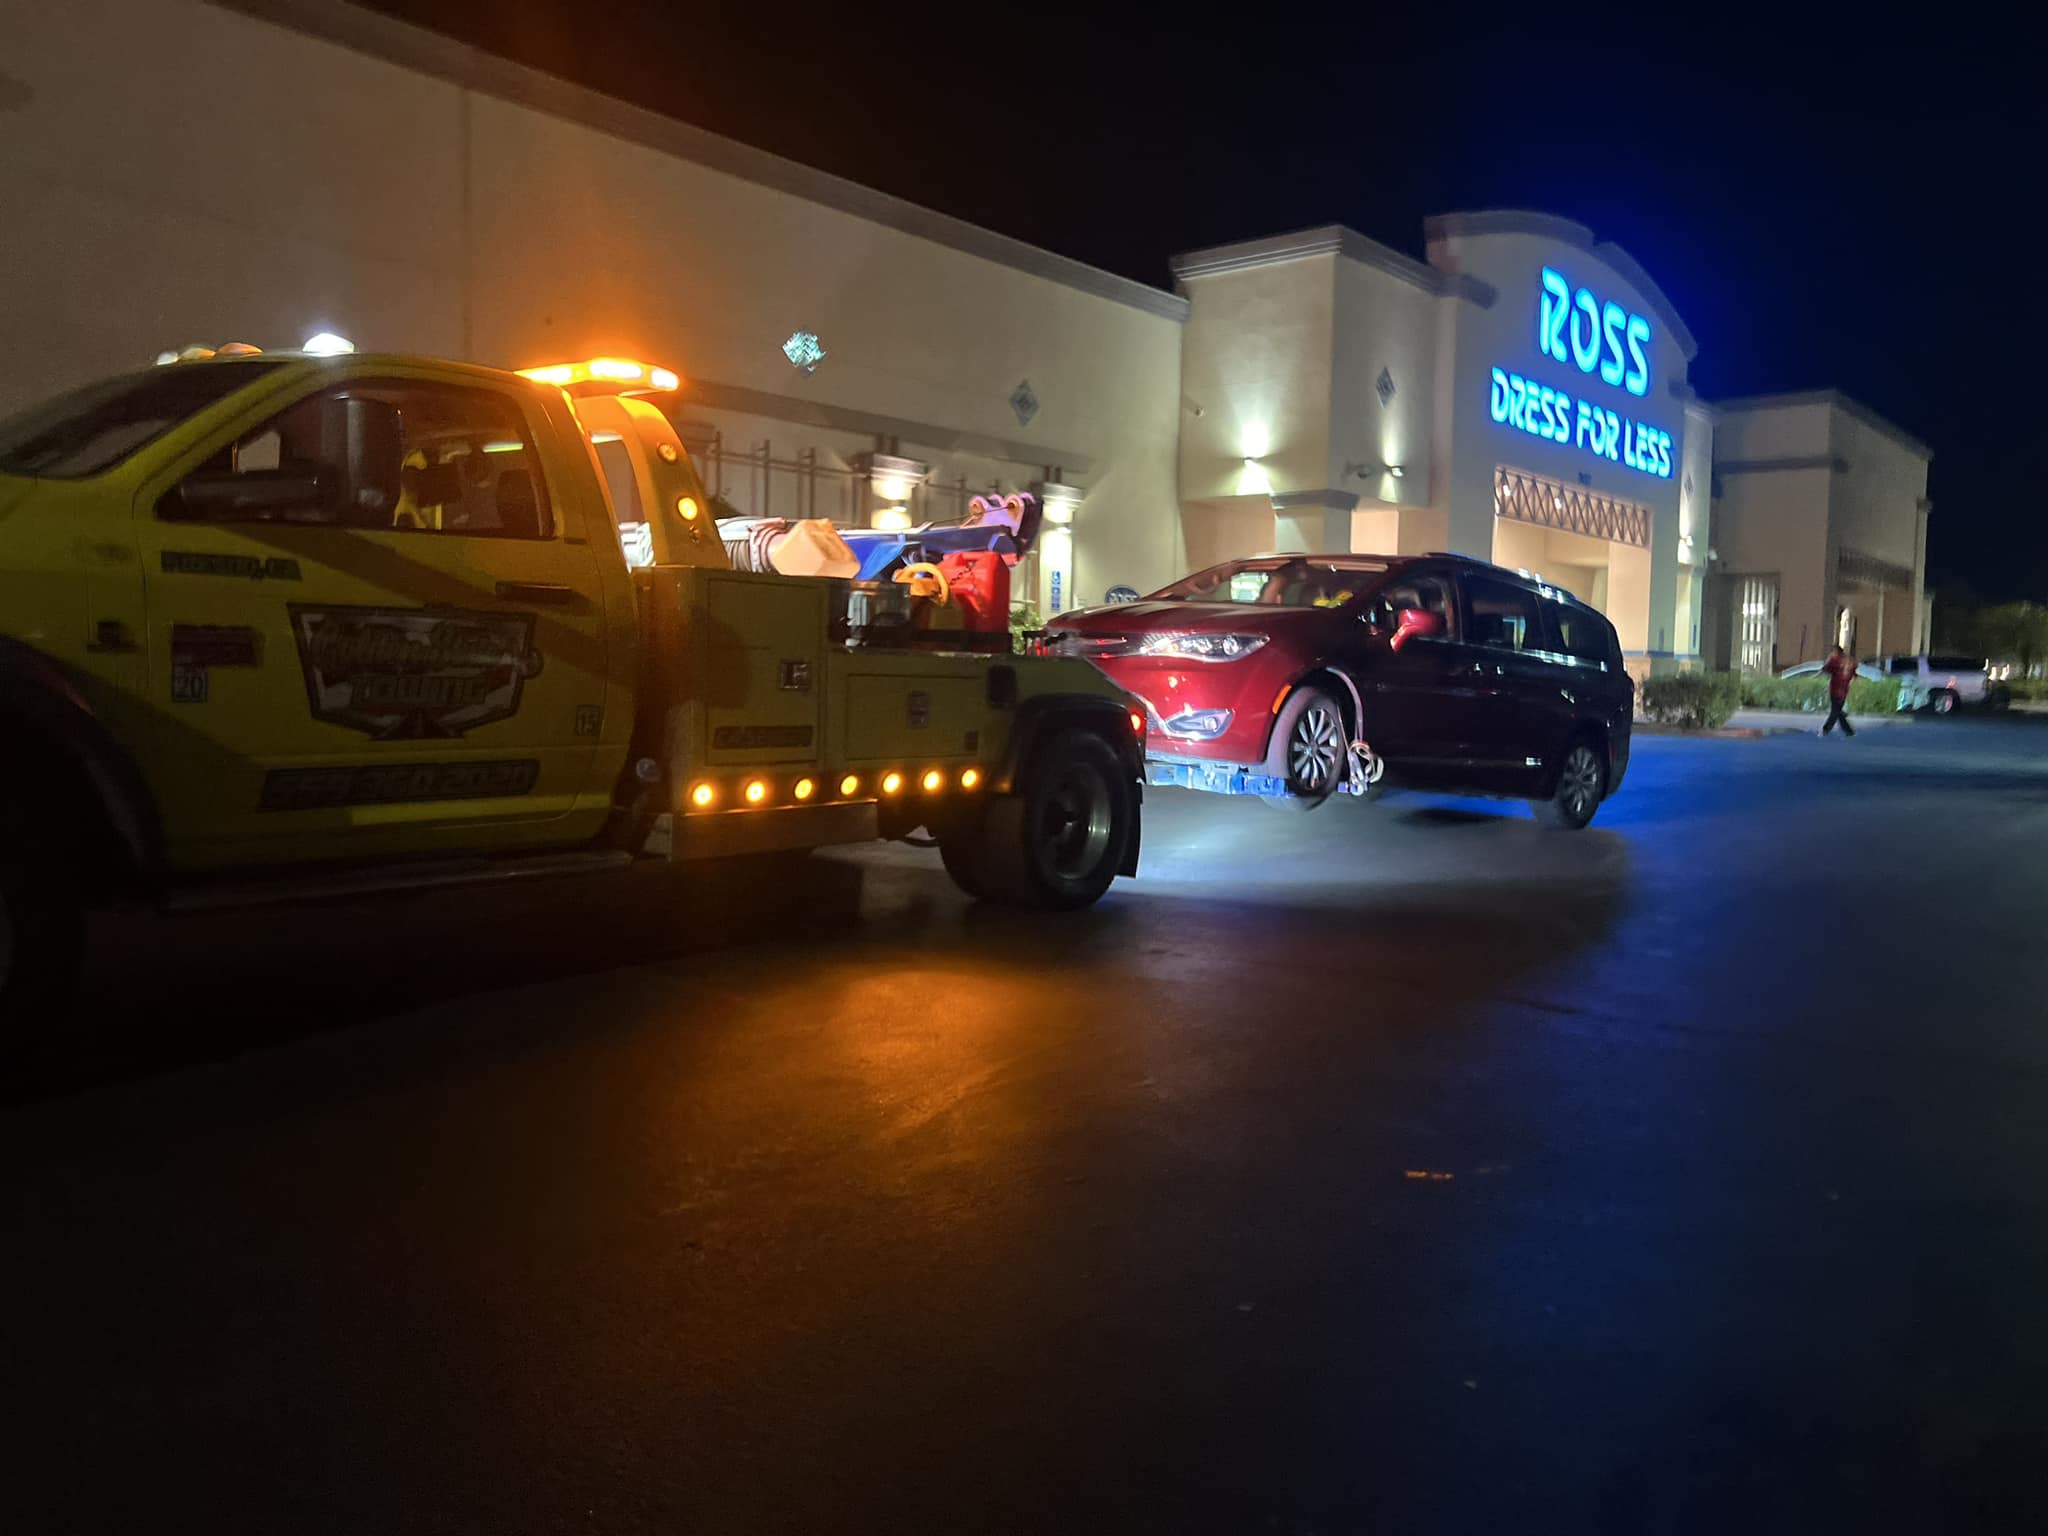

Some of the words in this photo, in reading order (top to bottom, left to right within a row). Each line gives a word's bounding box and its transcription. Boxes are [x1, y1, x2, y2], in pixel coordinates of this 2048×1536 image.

[1539, 264, 1652, 397] ROSS
[1490, 366, 1571, 445] DRESS
[1576, 399, 1620, 462] FOR
[1623, 417, 1673, 479] LESS
